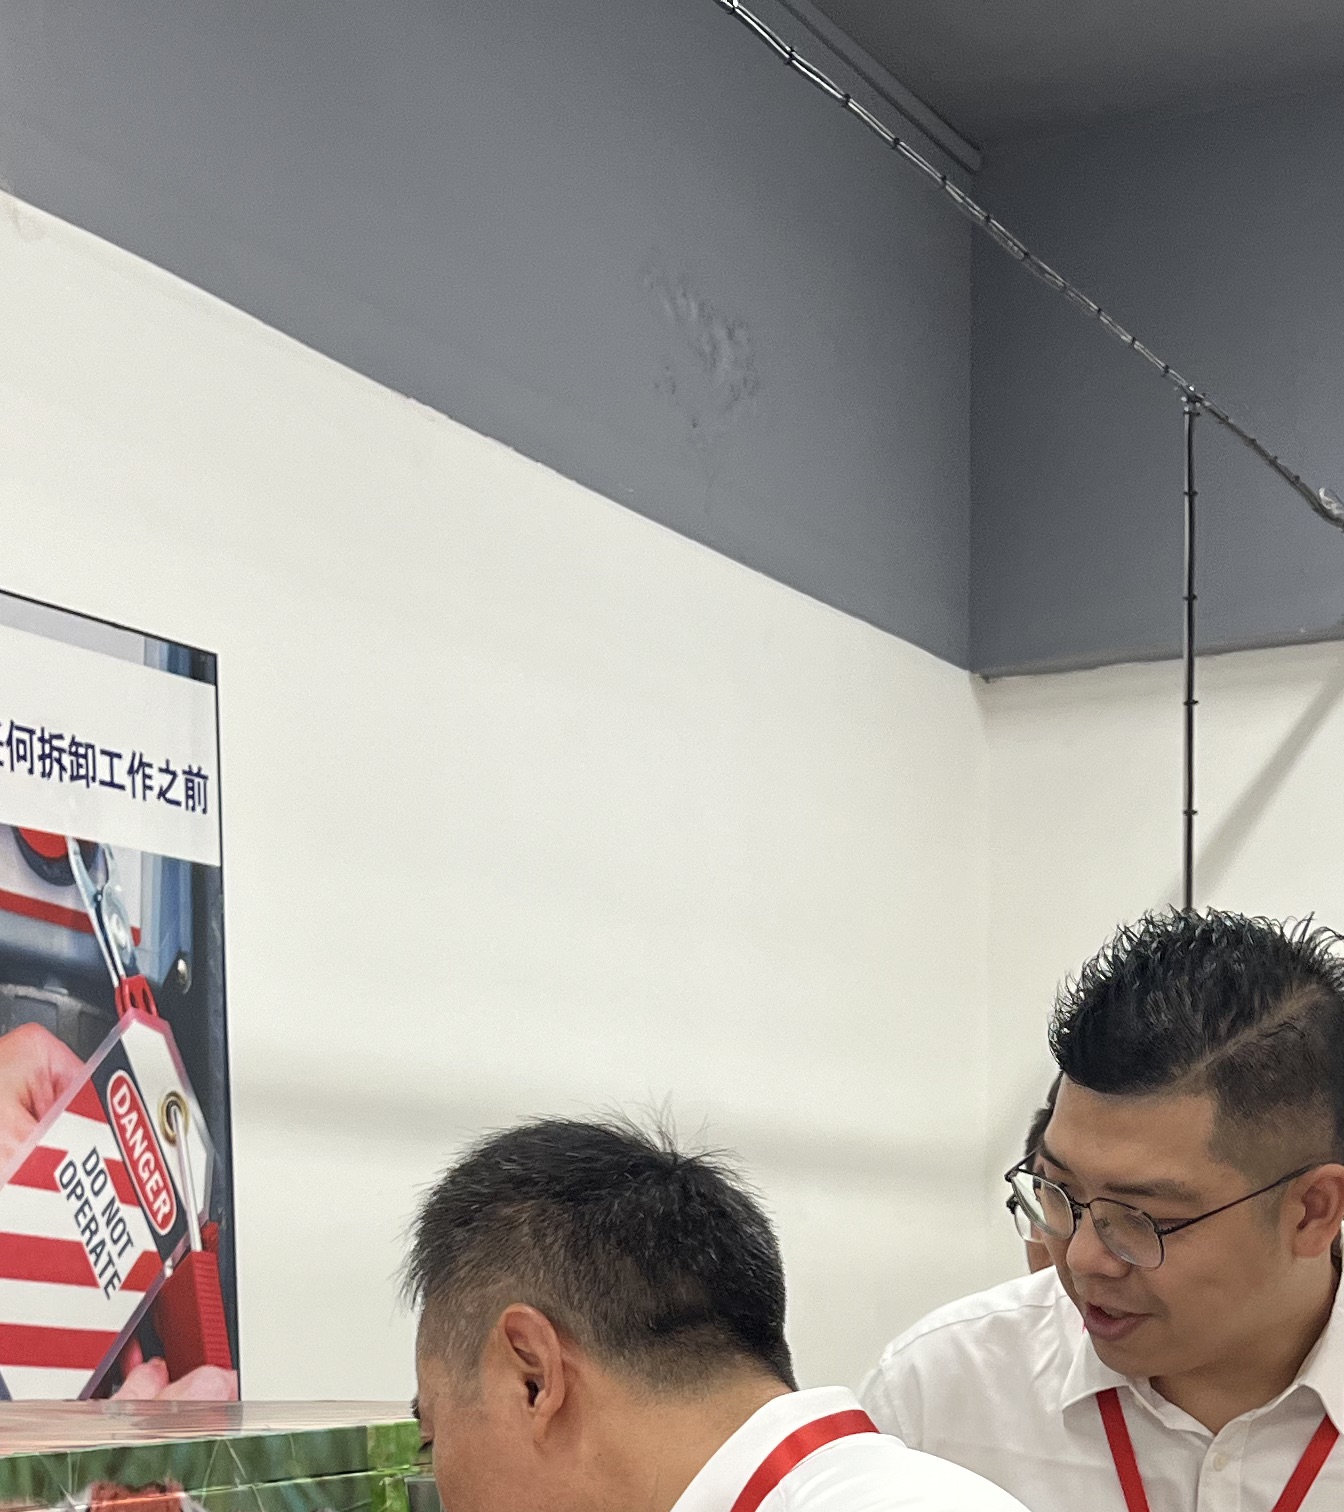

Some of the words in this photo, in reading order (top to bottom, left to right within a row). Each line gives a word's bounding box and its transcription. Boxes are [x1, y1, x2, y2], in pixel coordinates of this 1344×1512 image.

[82, 1146, 109, 1198] DO
[101, 1196, 135, 1260] NOT
[112, 1083, 172, 1225] DANGER
[59, 1160, 122, 1301] OPERATE
